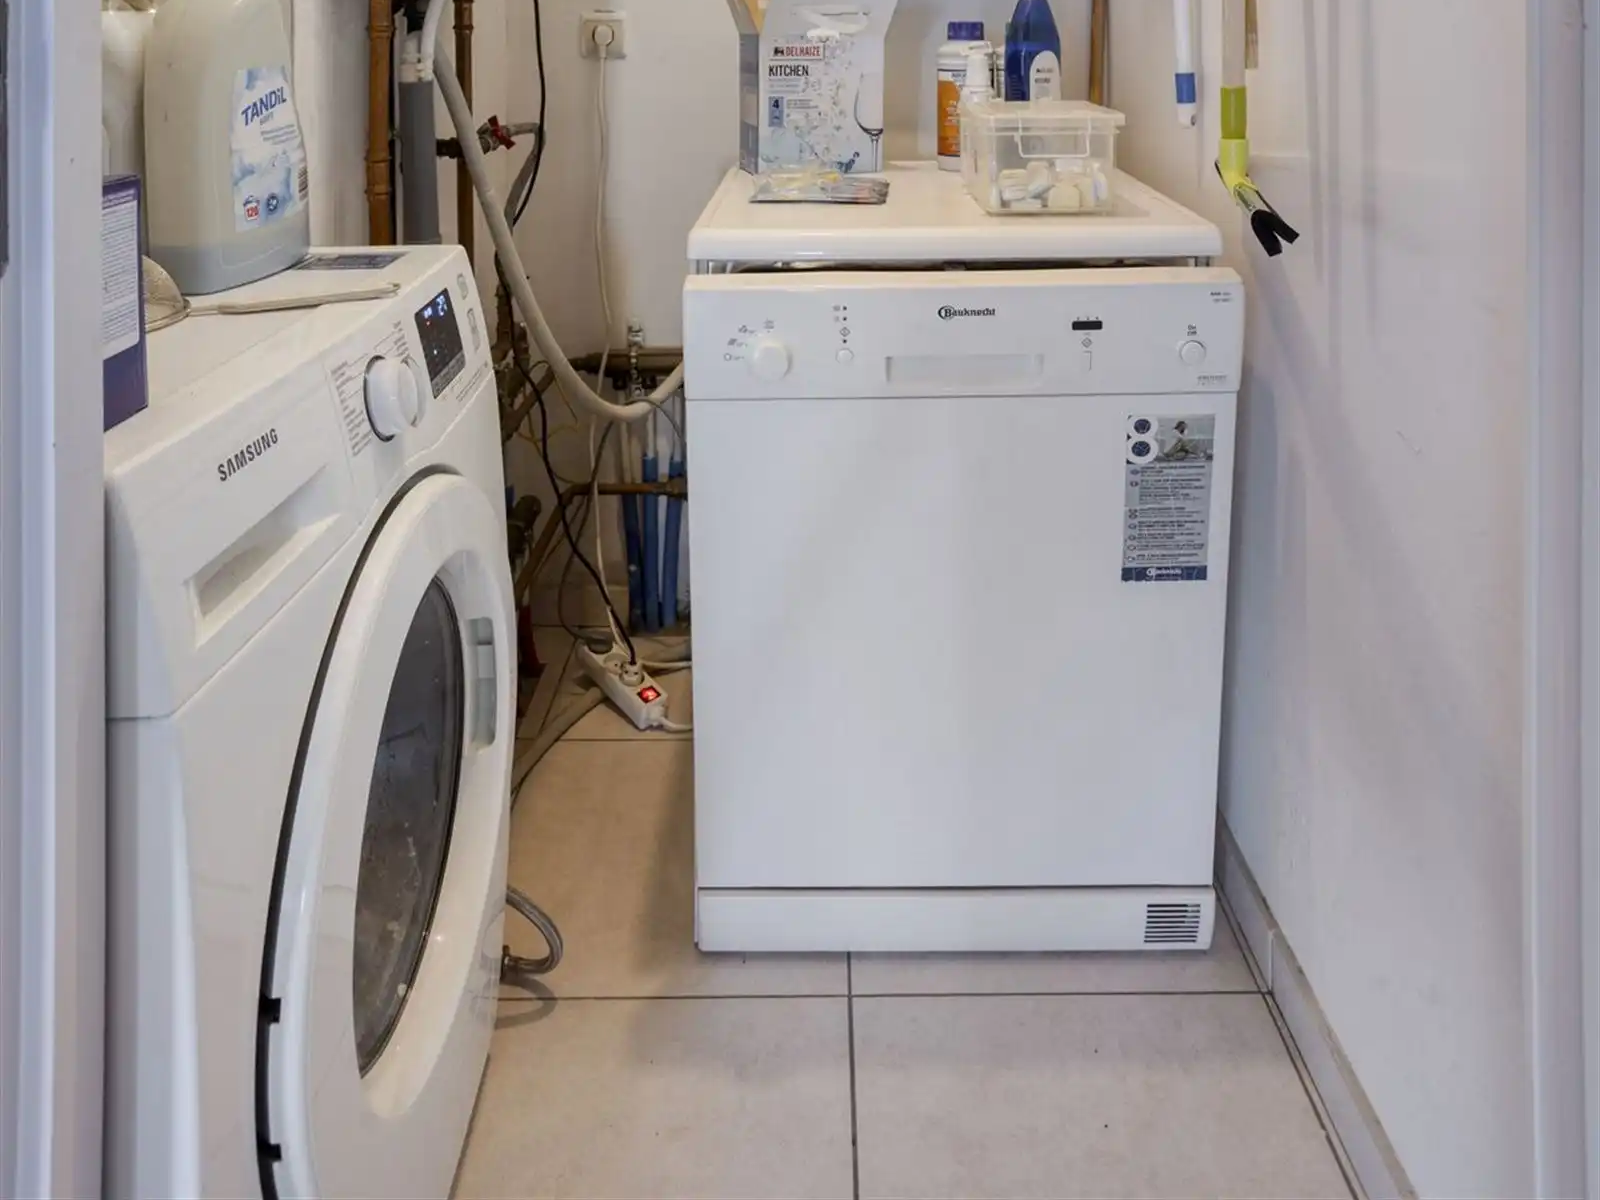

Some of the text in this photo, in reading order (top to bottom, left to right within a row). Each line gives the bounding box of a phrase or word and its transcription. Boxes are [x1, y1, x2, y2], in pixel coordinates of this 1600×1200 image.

[785, 46, 821, 57] DELHAIZE
[768, 64, 809, 77] KITCHEN
[772, 99, 780, 109] 4
[938, 305, 996, 320] Bauknecht
[217, 427, 279, 482] SAMSUNG
